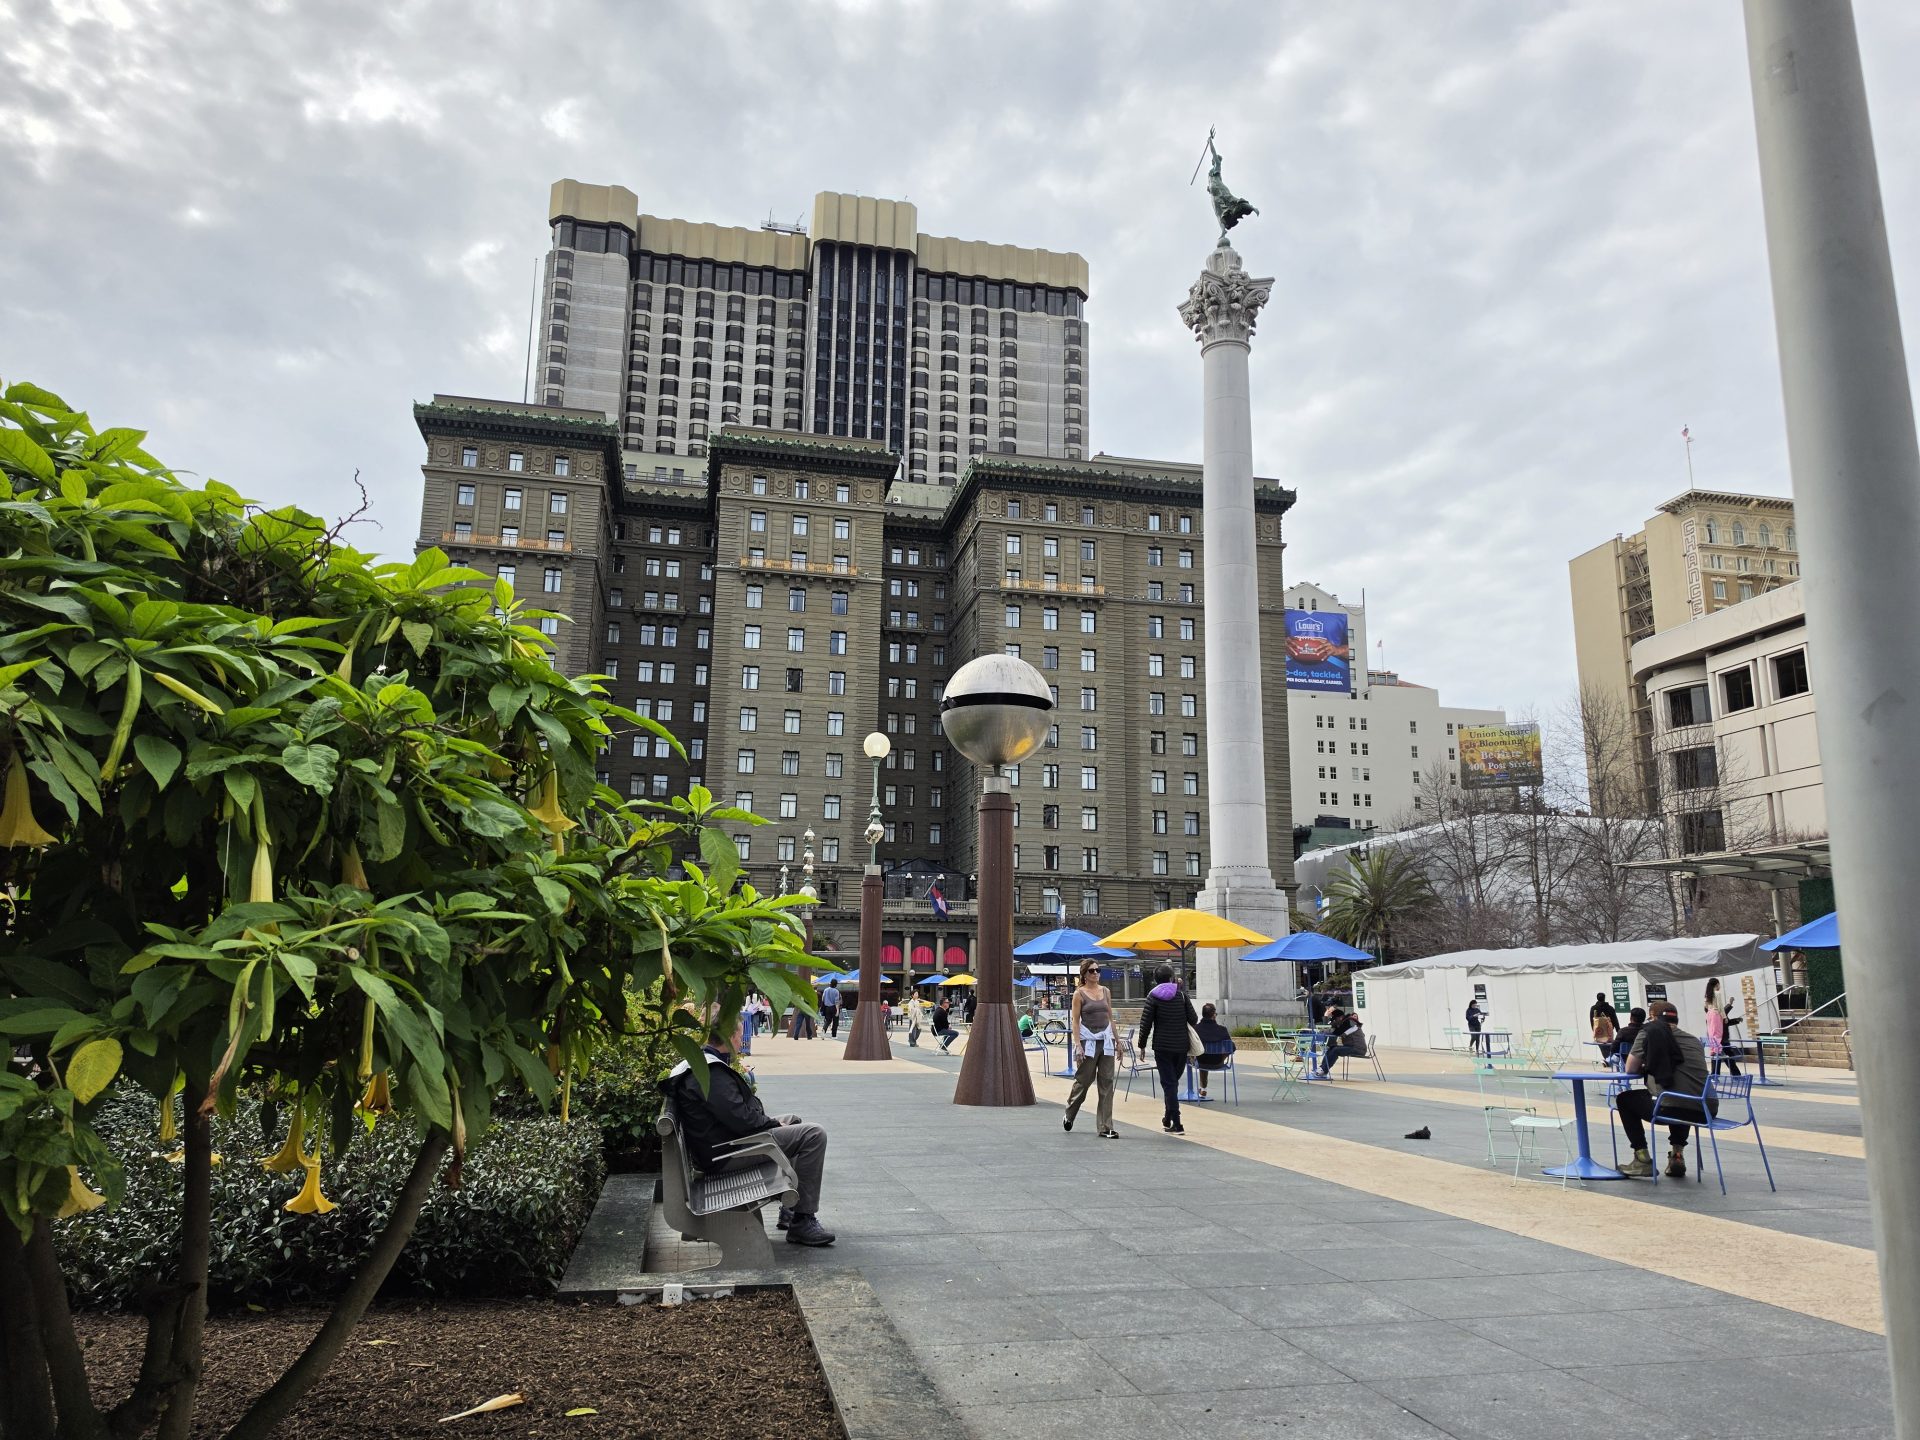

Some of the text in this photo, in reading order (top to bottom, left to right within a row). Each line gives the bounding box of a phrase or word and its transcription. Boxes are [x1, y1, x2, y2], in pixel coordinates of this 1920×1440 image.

[1683, 519, 1704, 620] CHANCE
[1286, 669, 1343, 679] o-dos, tackled.
[1469, 729, 1530, 739] Union Square
[1488, 761, 1506, 770] Post
